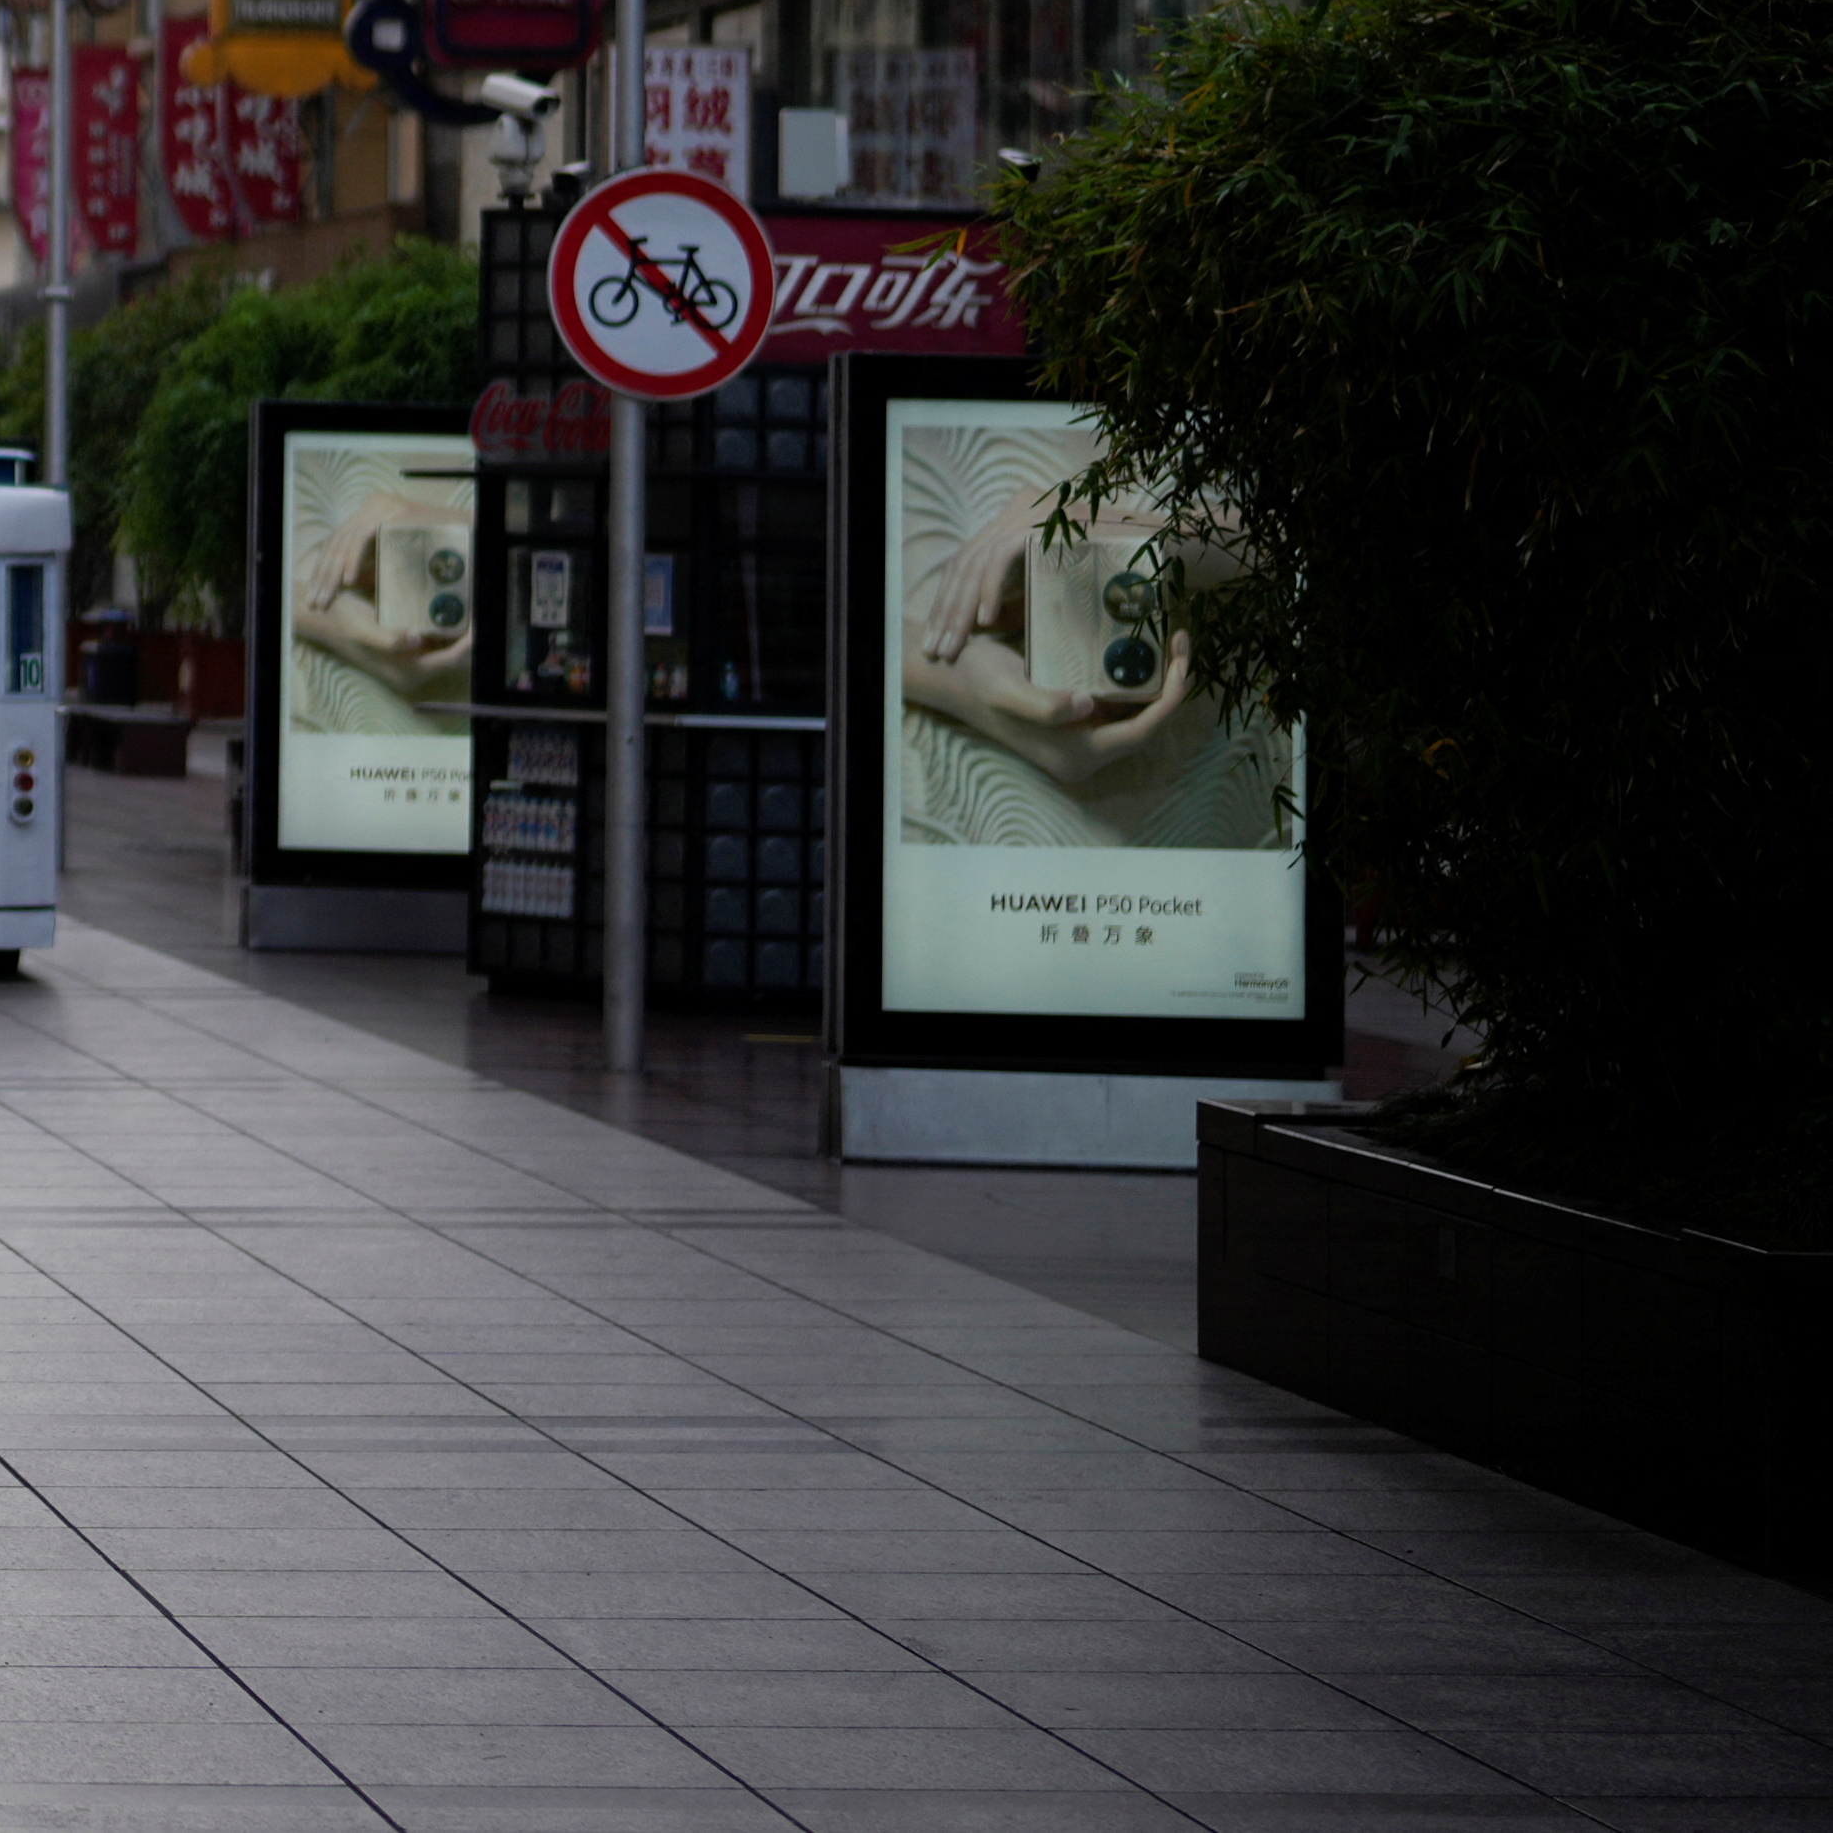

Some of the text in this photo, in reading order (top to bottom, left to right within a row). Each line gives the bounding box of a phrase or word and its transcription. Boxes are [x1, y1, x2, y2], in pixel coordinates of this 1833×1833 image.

[21, 659, 40, 687] 10
[350, 766, 415, 782] HUAWEI
[989, 892, 1203, 917] HUAWEI P50 Pocket
[1039, 923, 1155, 946] 折叠万象
